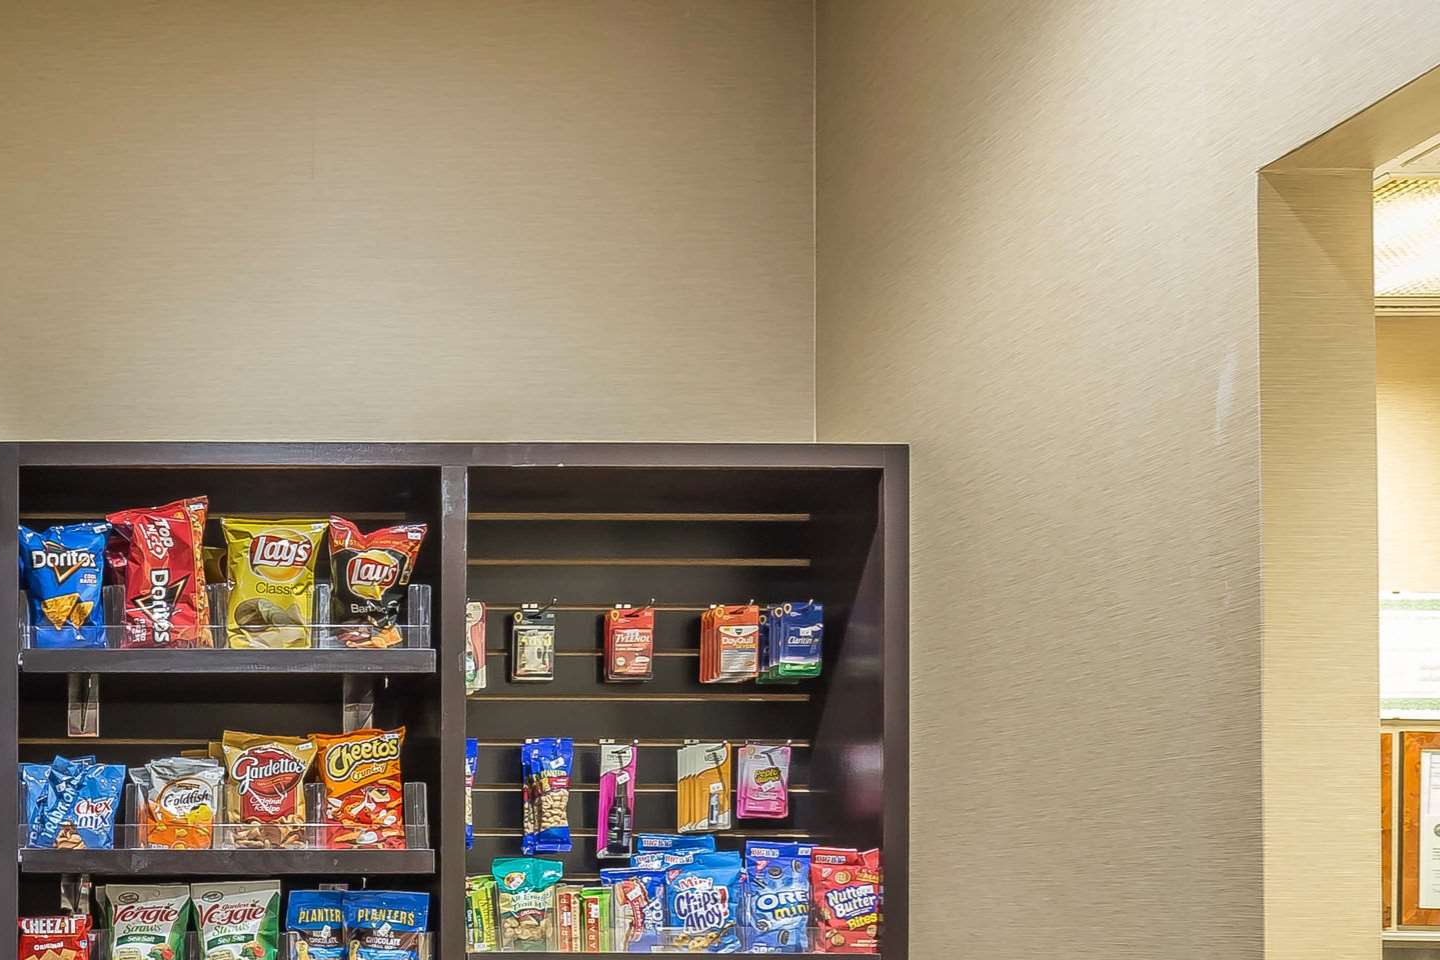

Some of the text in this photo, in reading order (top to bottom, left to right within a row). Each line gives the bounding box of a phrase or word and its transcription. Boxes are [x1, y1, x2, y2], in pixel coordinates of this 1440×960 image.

[32, 550, 96, 568] Doritos
[253, 536, 312, 567] Lay's
[351, 558, 398, 586] Lay's
[255, 581, 299, 595] Classic
[328, 738, 400, 777] Cheetos
[232, 757, 306, 795] Gardetto's
[75, 799, 113, 815] Chex
[163, 790, 211, 808] Goldfish
[756, 891, 809, 911] ORE
[835, 896, 877, 918] Butter
[298, 909, 342, 922] PLANTER
[357, 908, 415, 928] PLANTERS
[847, 913, 878, 930] Bites
